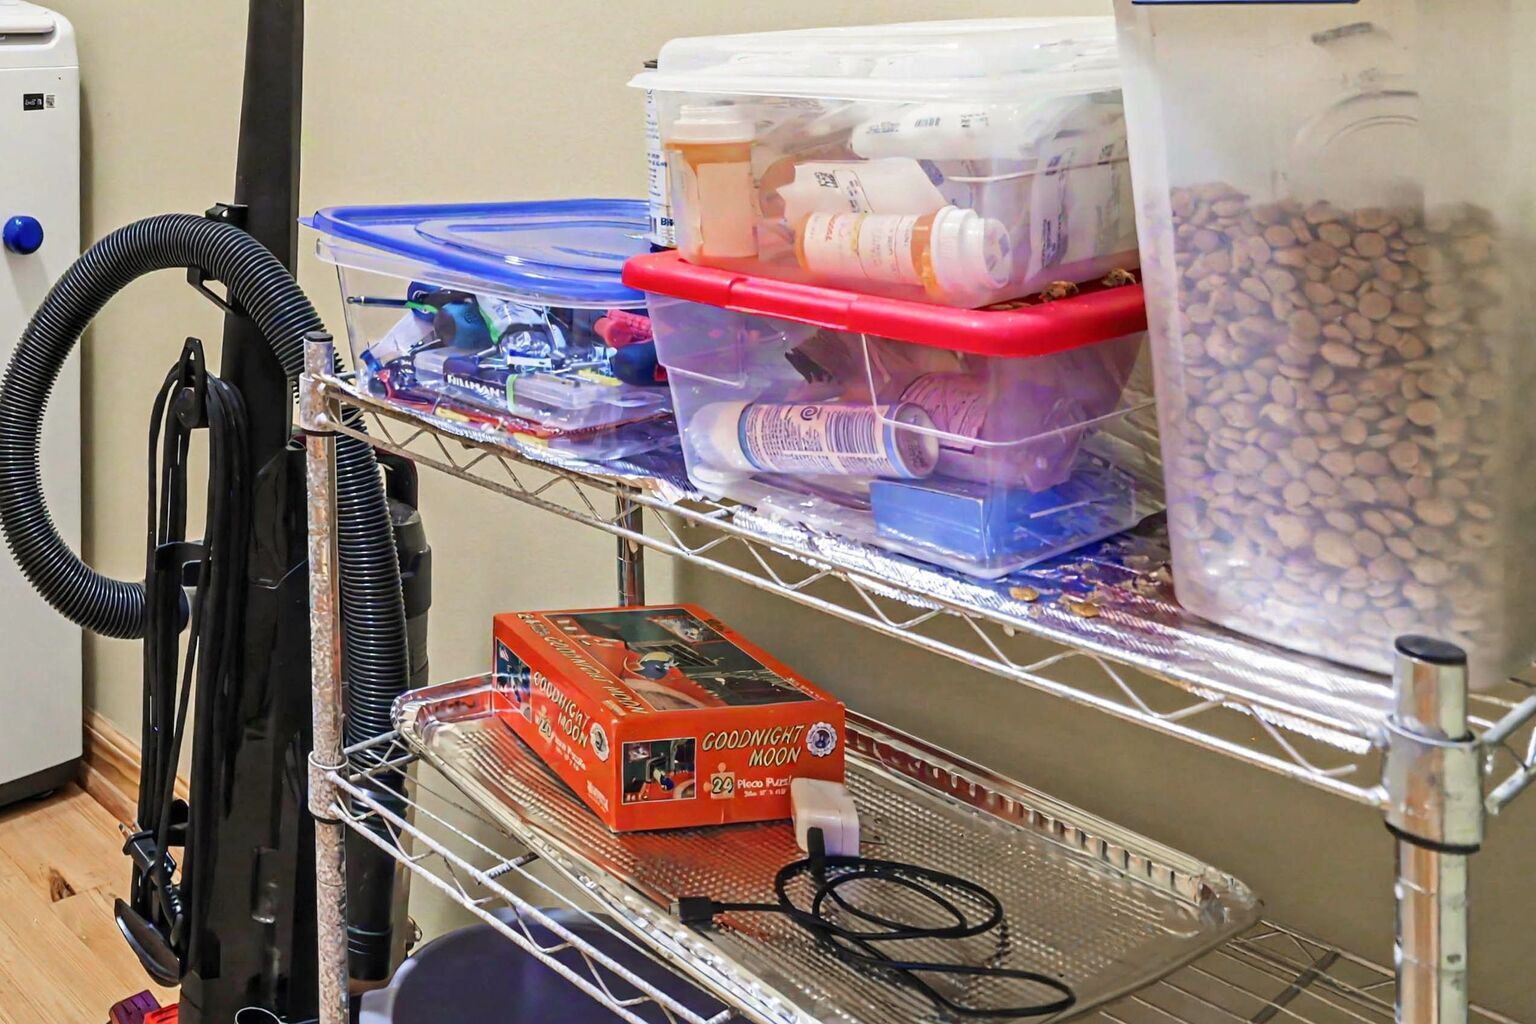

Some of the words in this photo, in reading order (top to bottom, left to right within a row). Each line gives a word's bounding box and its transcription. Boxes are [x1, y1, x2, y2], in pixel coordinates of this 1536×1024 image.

[447, 374, 500, 397] HILLMAN
[533, 671, 591, 729] GOODNIGHT
[557, 712, 589, 749] MOON
[702, 725, 805, 751] GOODNIGHT
[748, 746, 802, 767] MOON
[712, 776, 734, 794] 24
[765, 775, 792, 788] Puzzl
